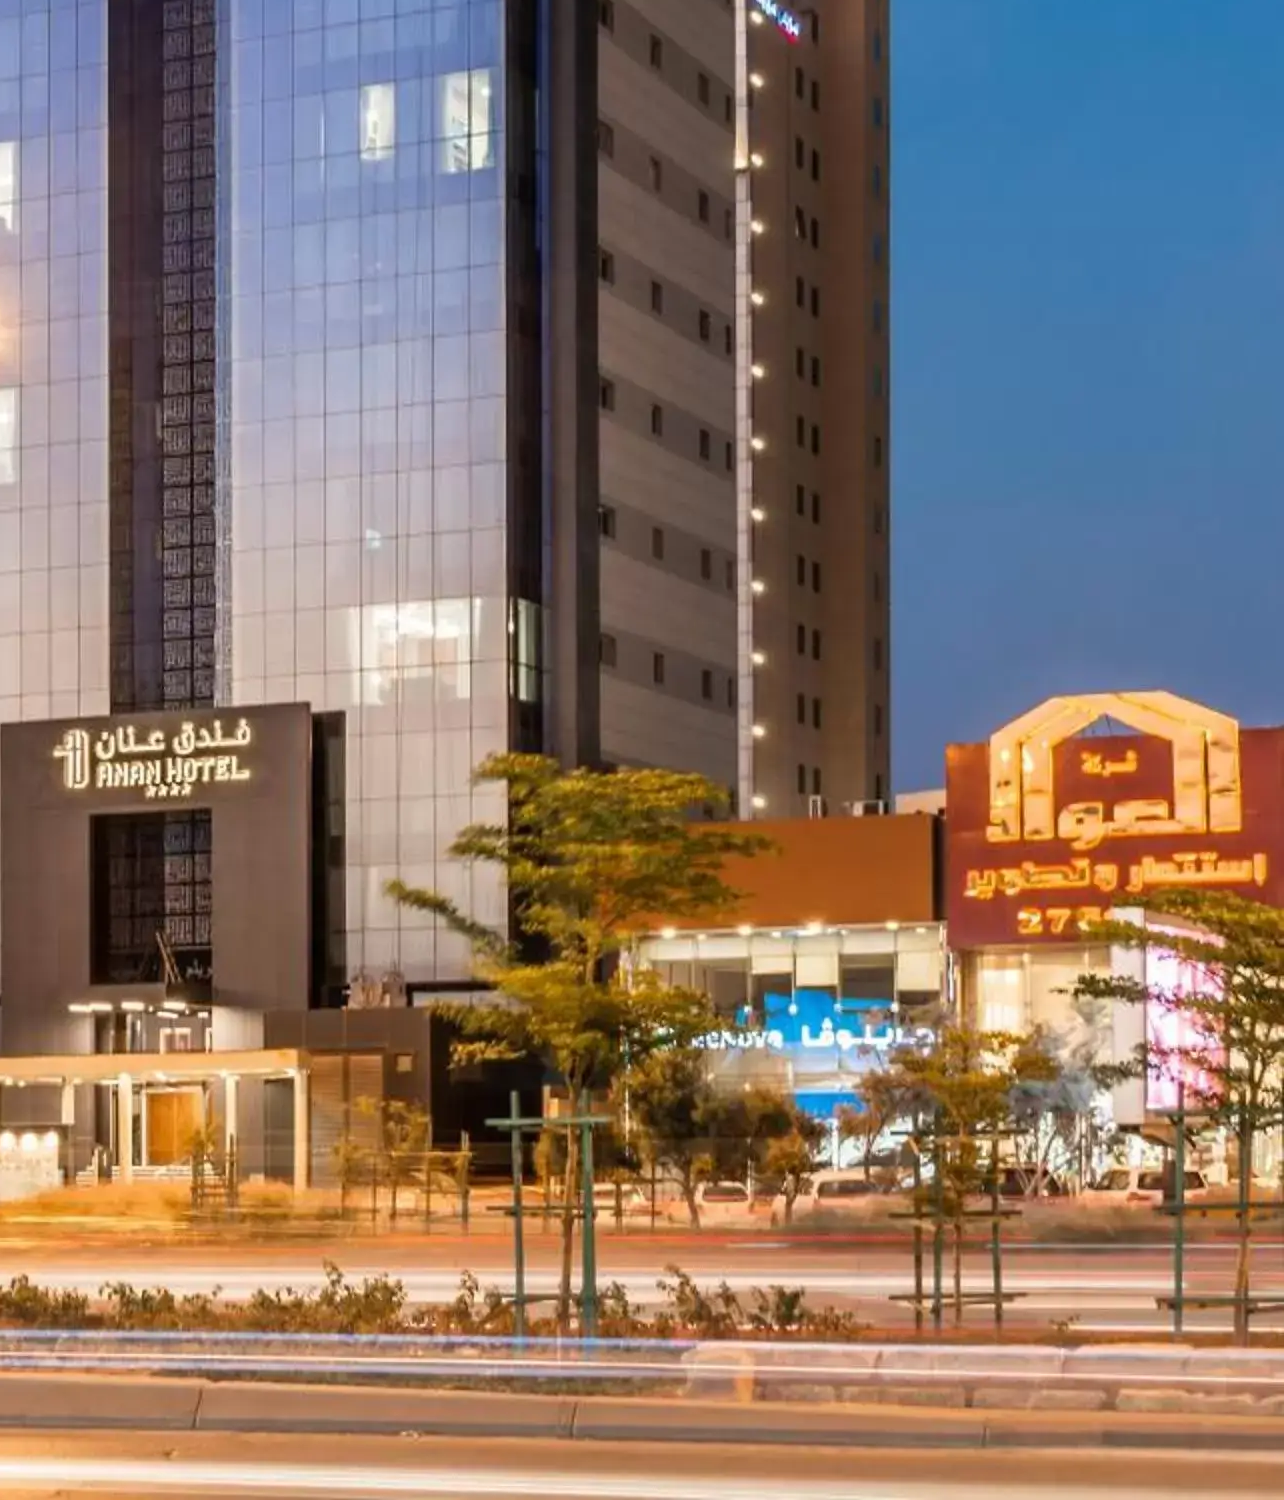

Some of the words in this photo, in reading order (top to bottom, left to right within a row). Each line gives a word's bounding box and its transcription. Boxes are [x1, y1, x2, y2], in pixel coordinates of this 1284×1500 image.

[95, 724, 166, 760] عنان
[172, 717, 251, 755] فندق
[166, 755, 251, 783] HOTEL
